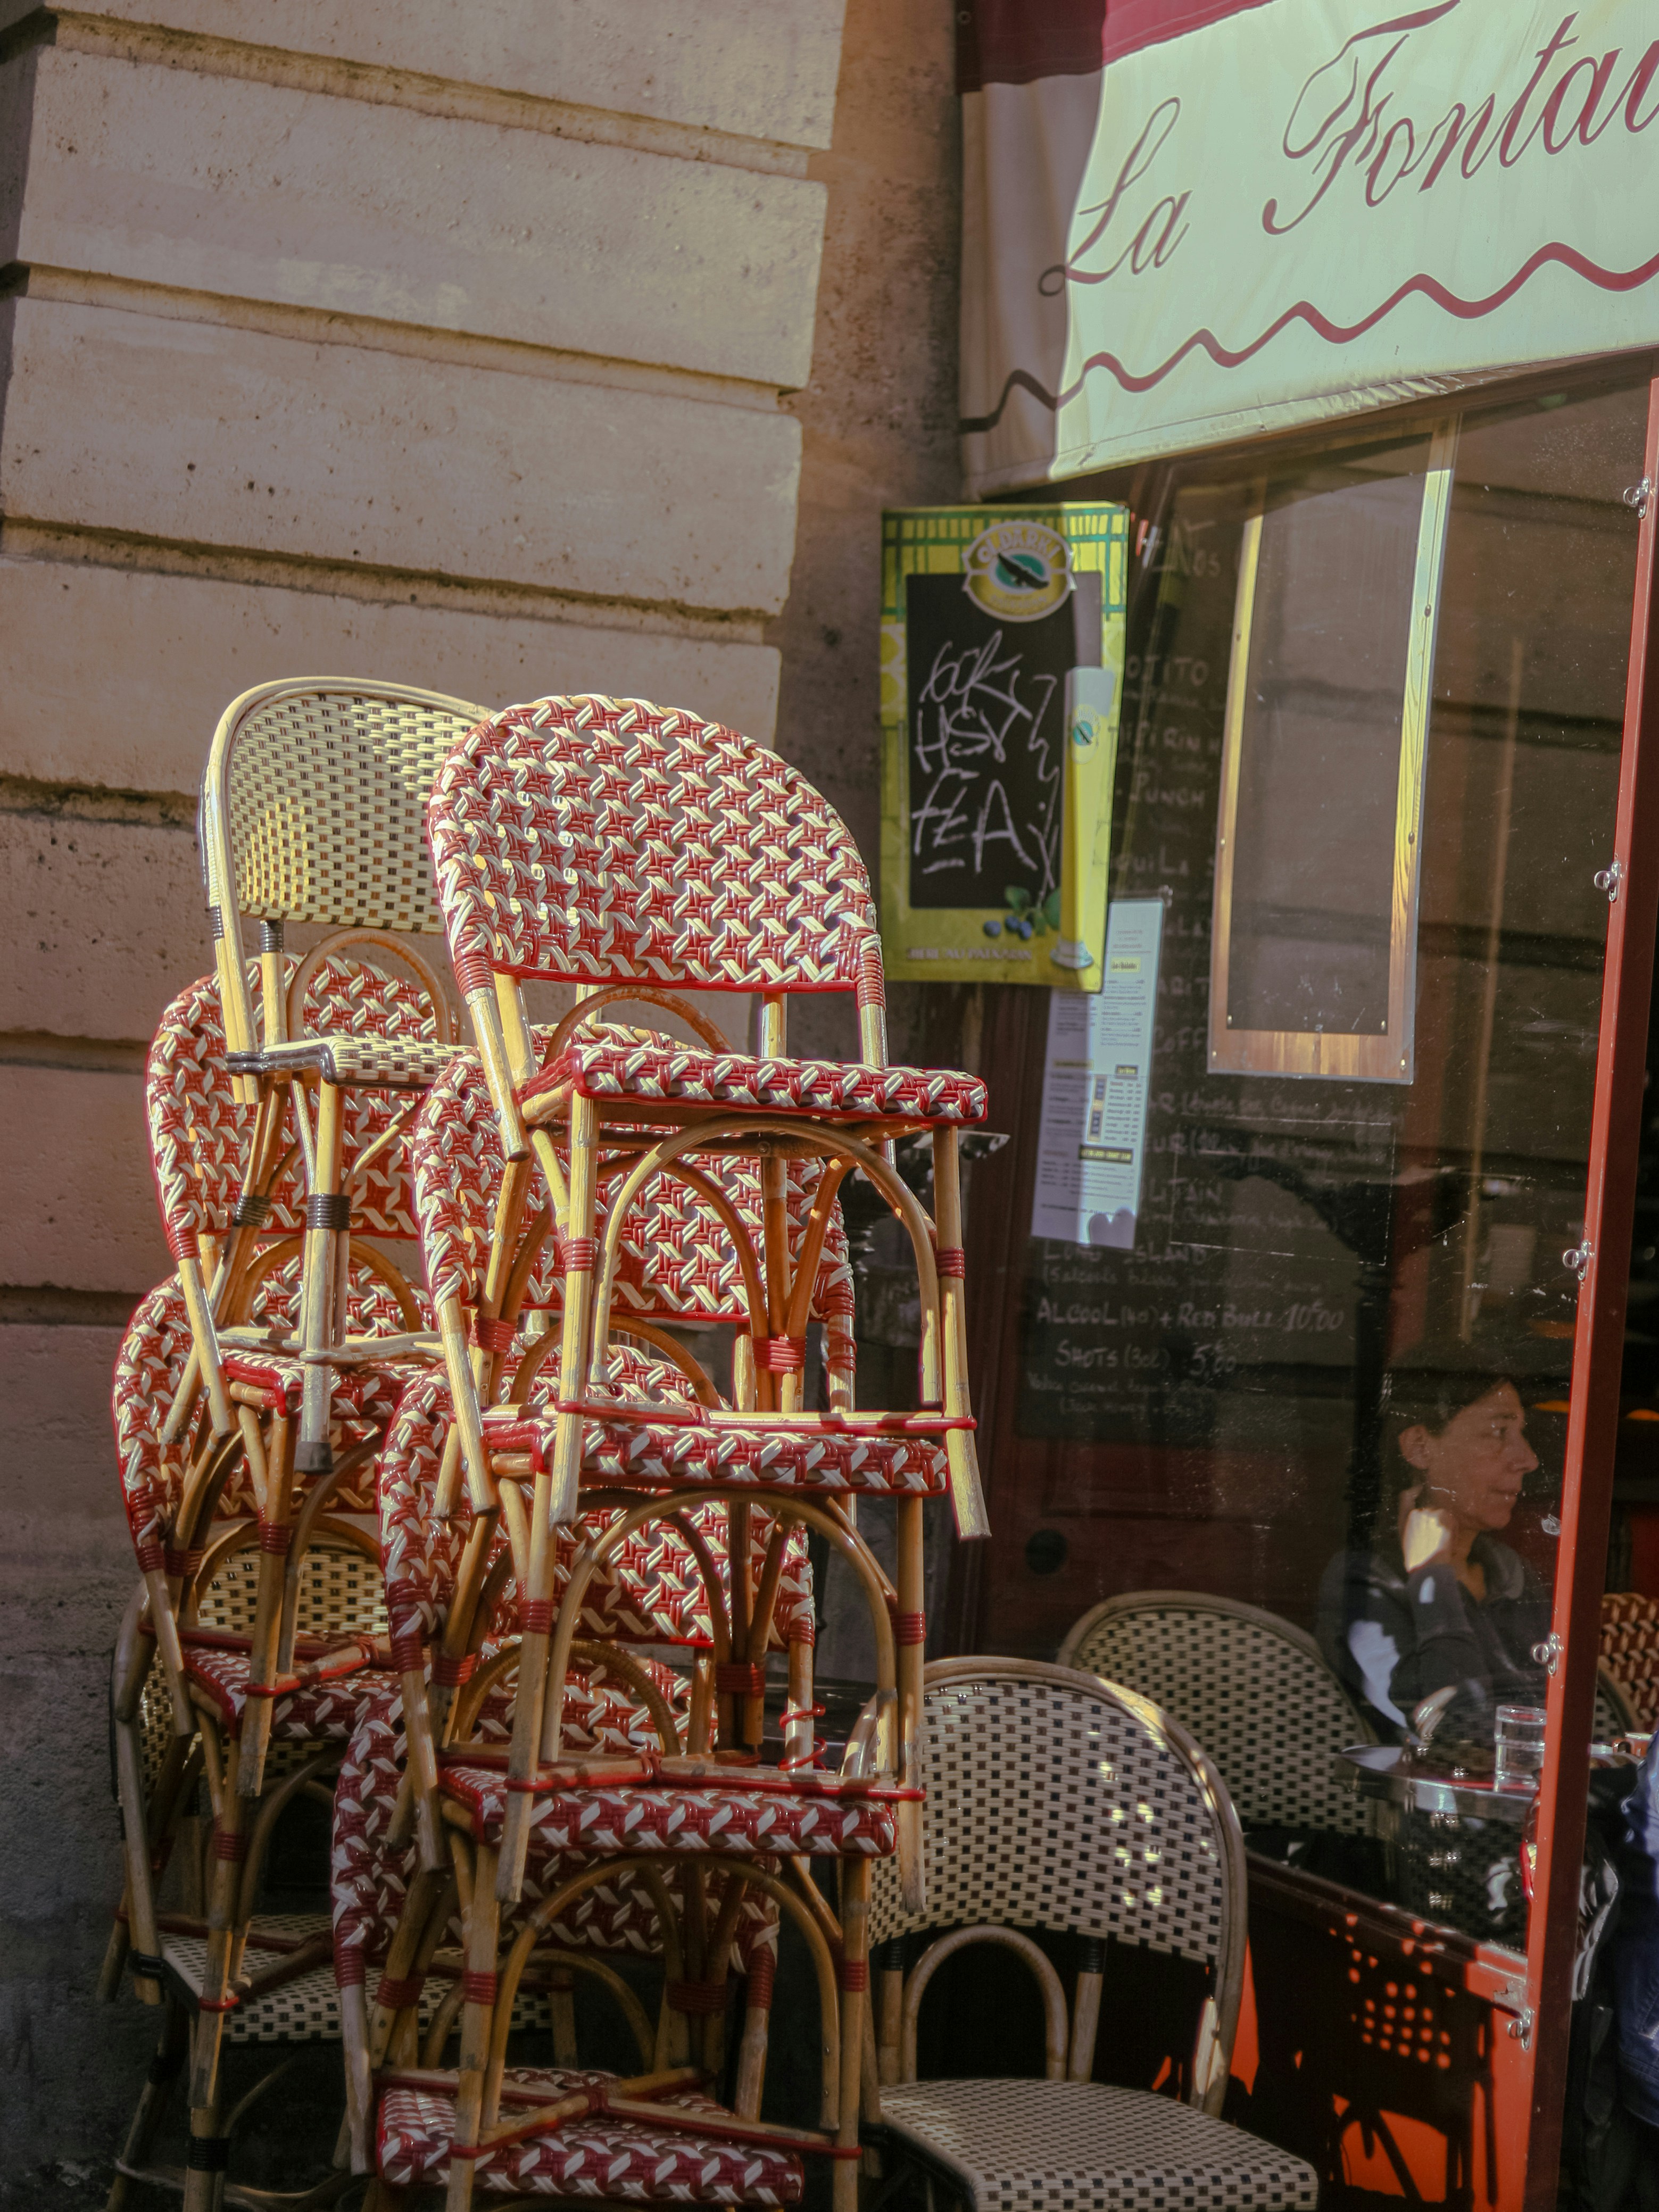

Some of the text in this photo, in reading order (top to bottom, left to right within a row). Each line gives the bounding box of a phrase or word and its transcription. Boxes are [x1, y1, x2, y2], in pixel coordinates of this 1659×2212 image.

[1038, 96, 1193, 296] La
[1037, 1299, 1118, 1326] ALCOOL
[1176, 1301, 1216, 1328] RED
[1221, 1303, 1273, 1328] BULL
[1054, 1338, 1118, 1368] SHOTS
